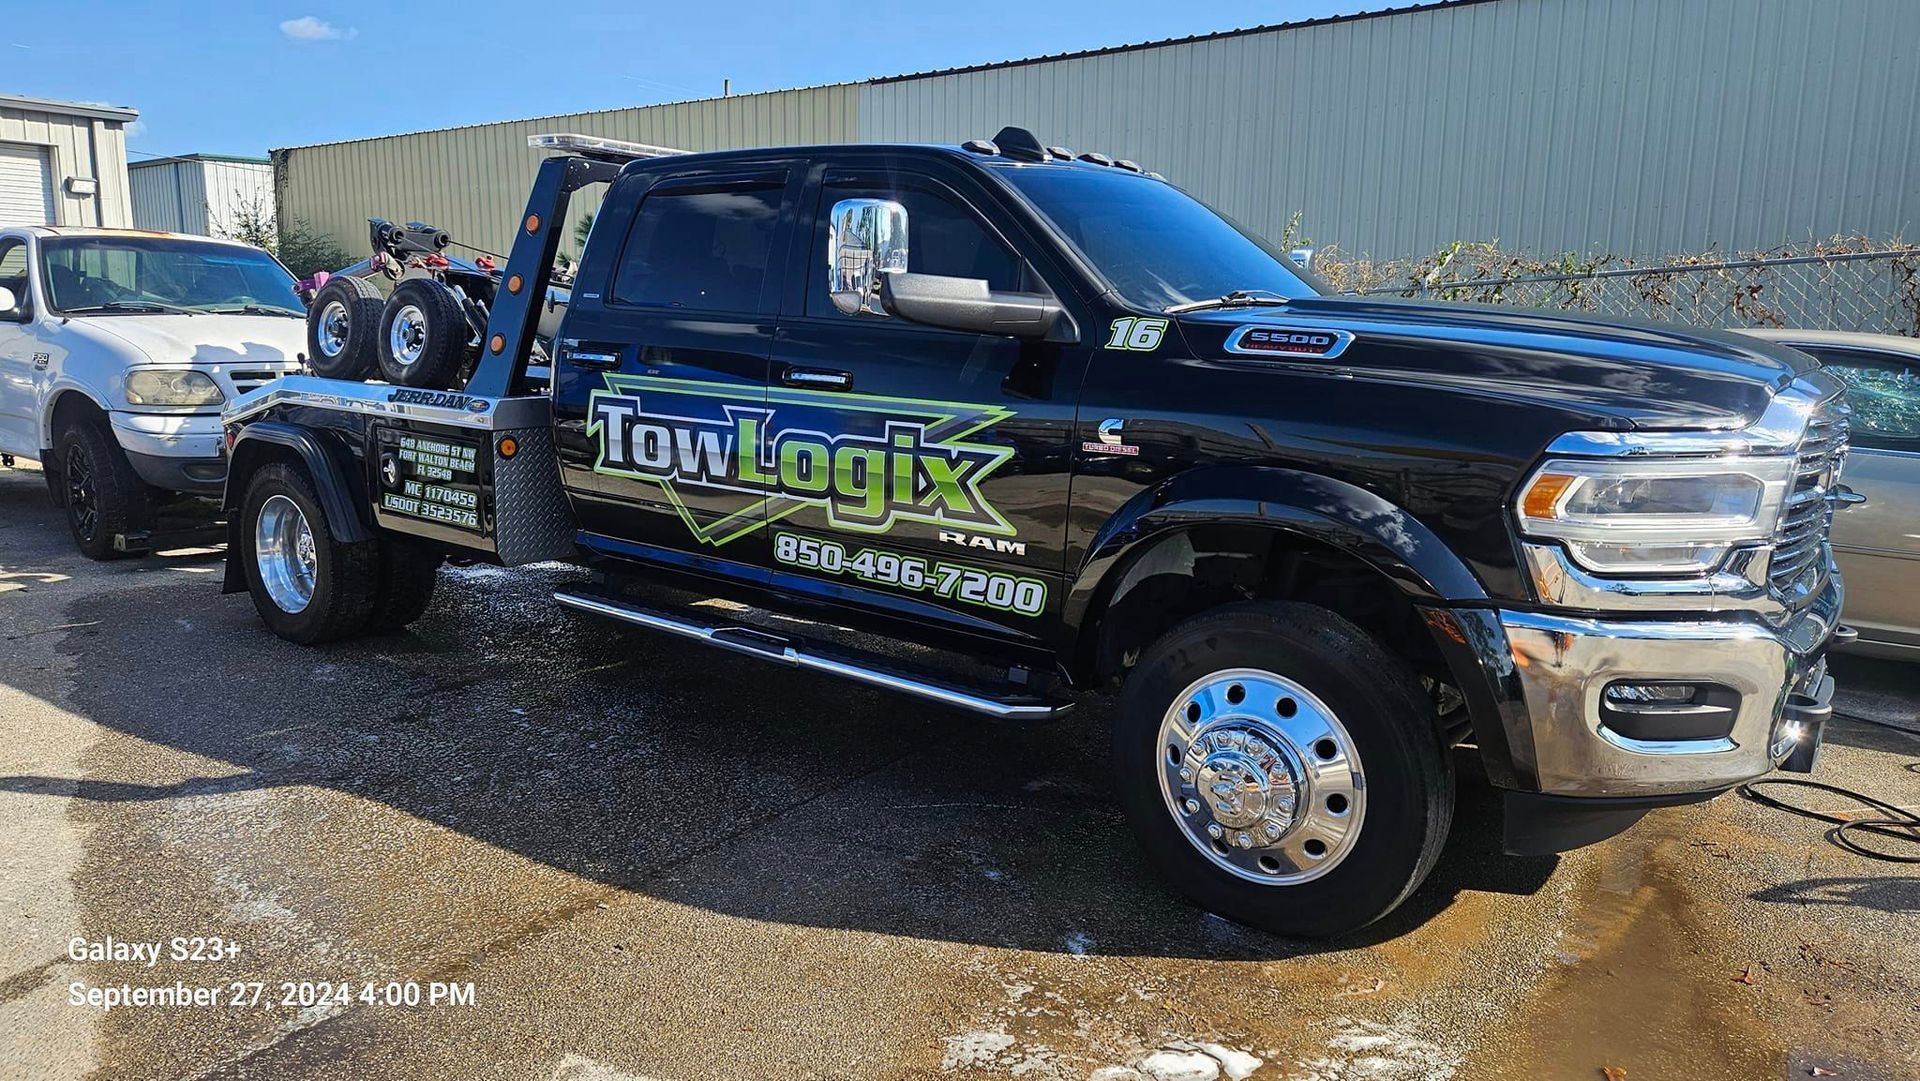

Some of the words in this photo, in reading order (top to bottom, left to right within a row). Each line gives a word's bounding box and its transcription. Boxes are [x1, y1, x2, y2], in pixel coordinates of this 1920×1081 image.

[1106, 317, 1168, 351] 16
[1250, 332, 1330, 345] 5500
[1244, 343, 1289, 351] HEAVY
[1290, 345, 1325, 353] DUTY
[399, 449, 416, 462] FORT
[418, 452, 449, 468] WALTON
[449, 457, 475, 473] BEACH
[400, 437, 415, 449] 648
[416, 440, 450, 456] ANCHORS
[451, 445, 461, 457] ST
[462, 447, 477, 460] NW
[1110, 446, 1137, 454] DIESEL
[417, 464, 426, 476] FL
[427, 466, 452, 481] 32548
[597, 404, 978, 519] TowLogix
[404, 480, 422, 497] MC
[424, 485, 477, 508] 1170459
[384, 494, 420, 514] USDOT
[421, 502, 478, 527] 3523576
[938, 530, 1027, 556] RAM
[774, 534, 1046, 615] 850-496-7200
